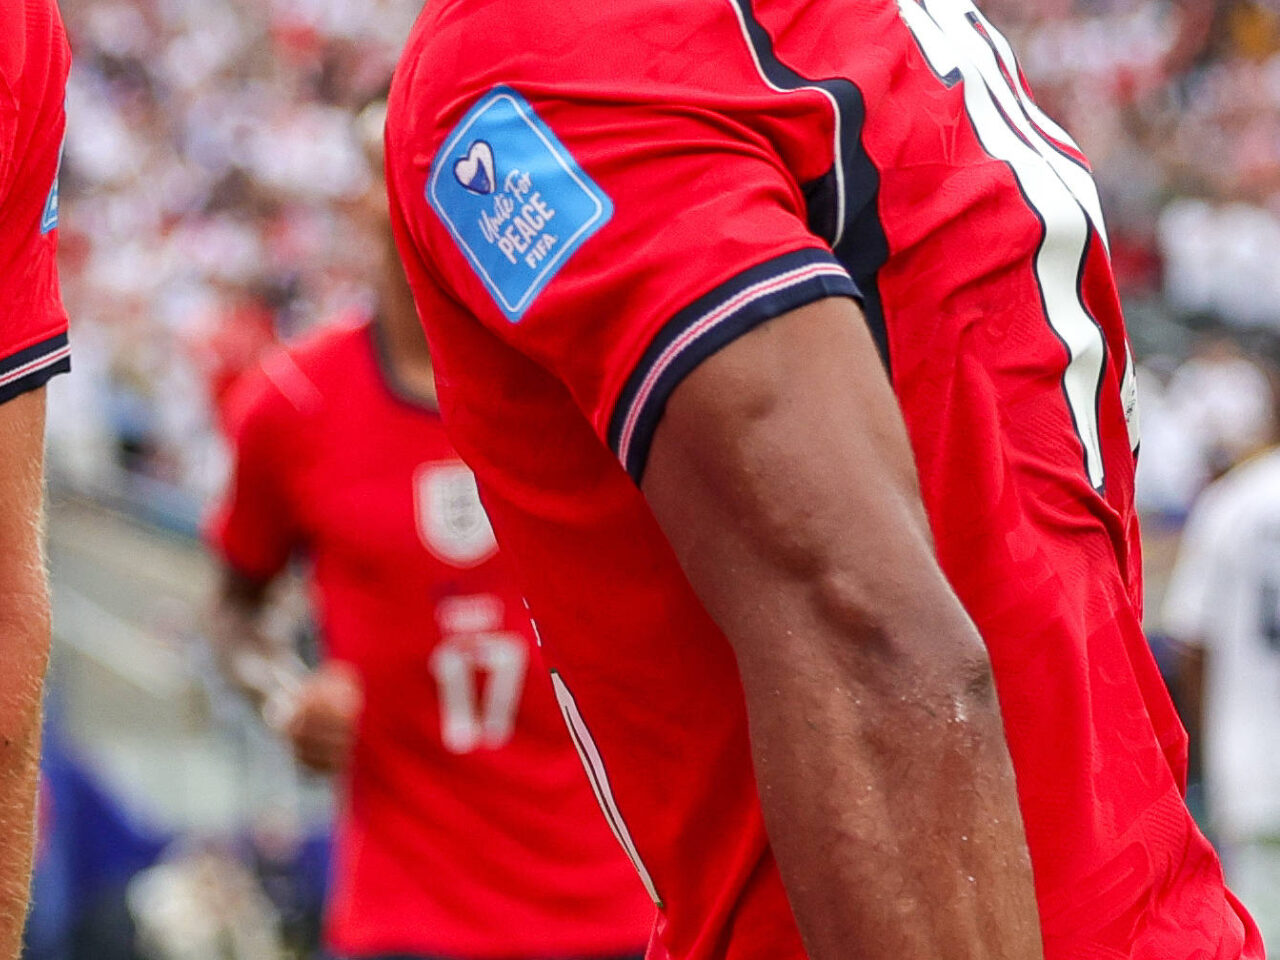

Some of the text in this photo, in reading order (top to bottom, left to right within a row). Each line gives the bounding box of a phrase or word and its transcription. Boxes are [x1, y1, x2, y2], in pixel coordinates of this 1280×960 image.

[497, 191, 556, 265] PEACE
[524, 233, 558, 270] FIFA
[427, 631, 530, 755] 17
